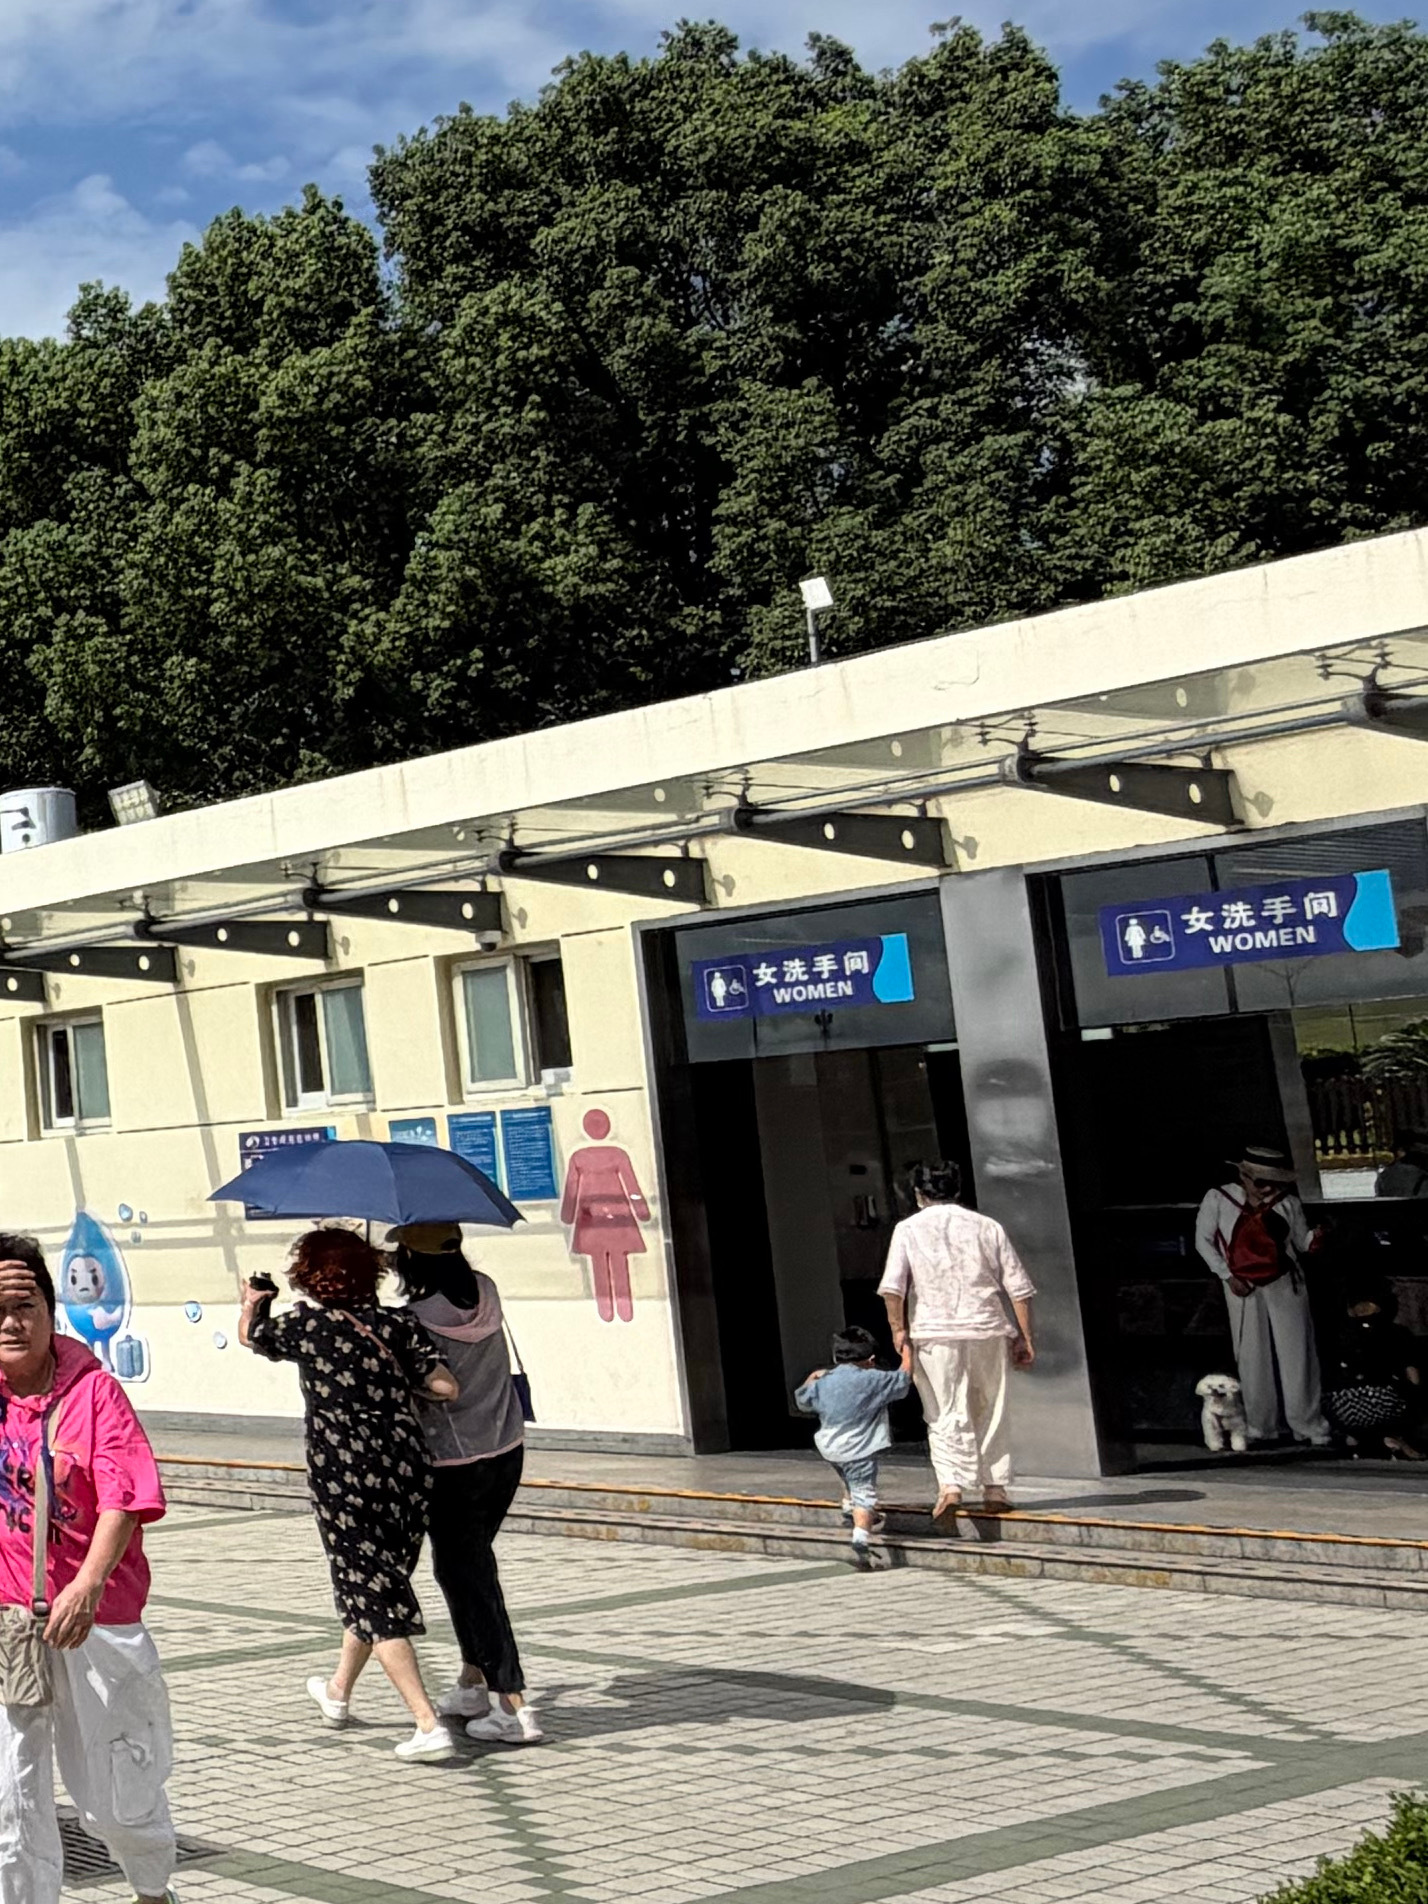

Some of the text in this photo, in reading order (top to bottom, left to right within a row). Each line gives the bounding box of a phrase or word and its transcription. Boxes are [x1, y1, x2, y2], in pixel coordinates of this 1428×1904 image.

[1180, 891, 1338, 935] 女洗手间
[1208, 925, 1316, 954] WOMEN
[752, 950, 870, 987] 女洗手间
[773, 980, 854, 1004] WOMEN
